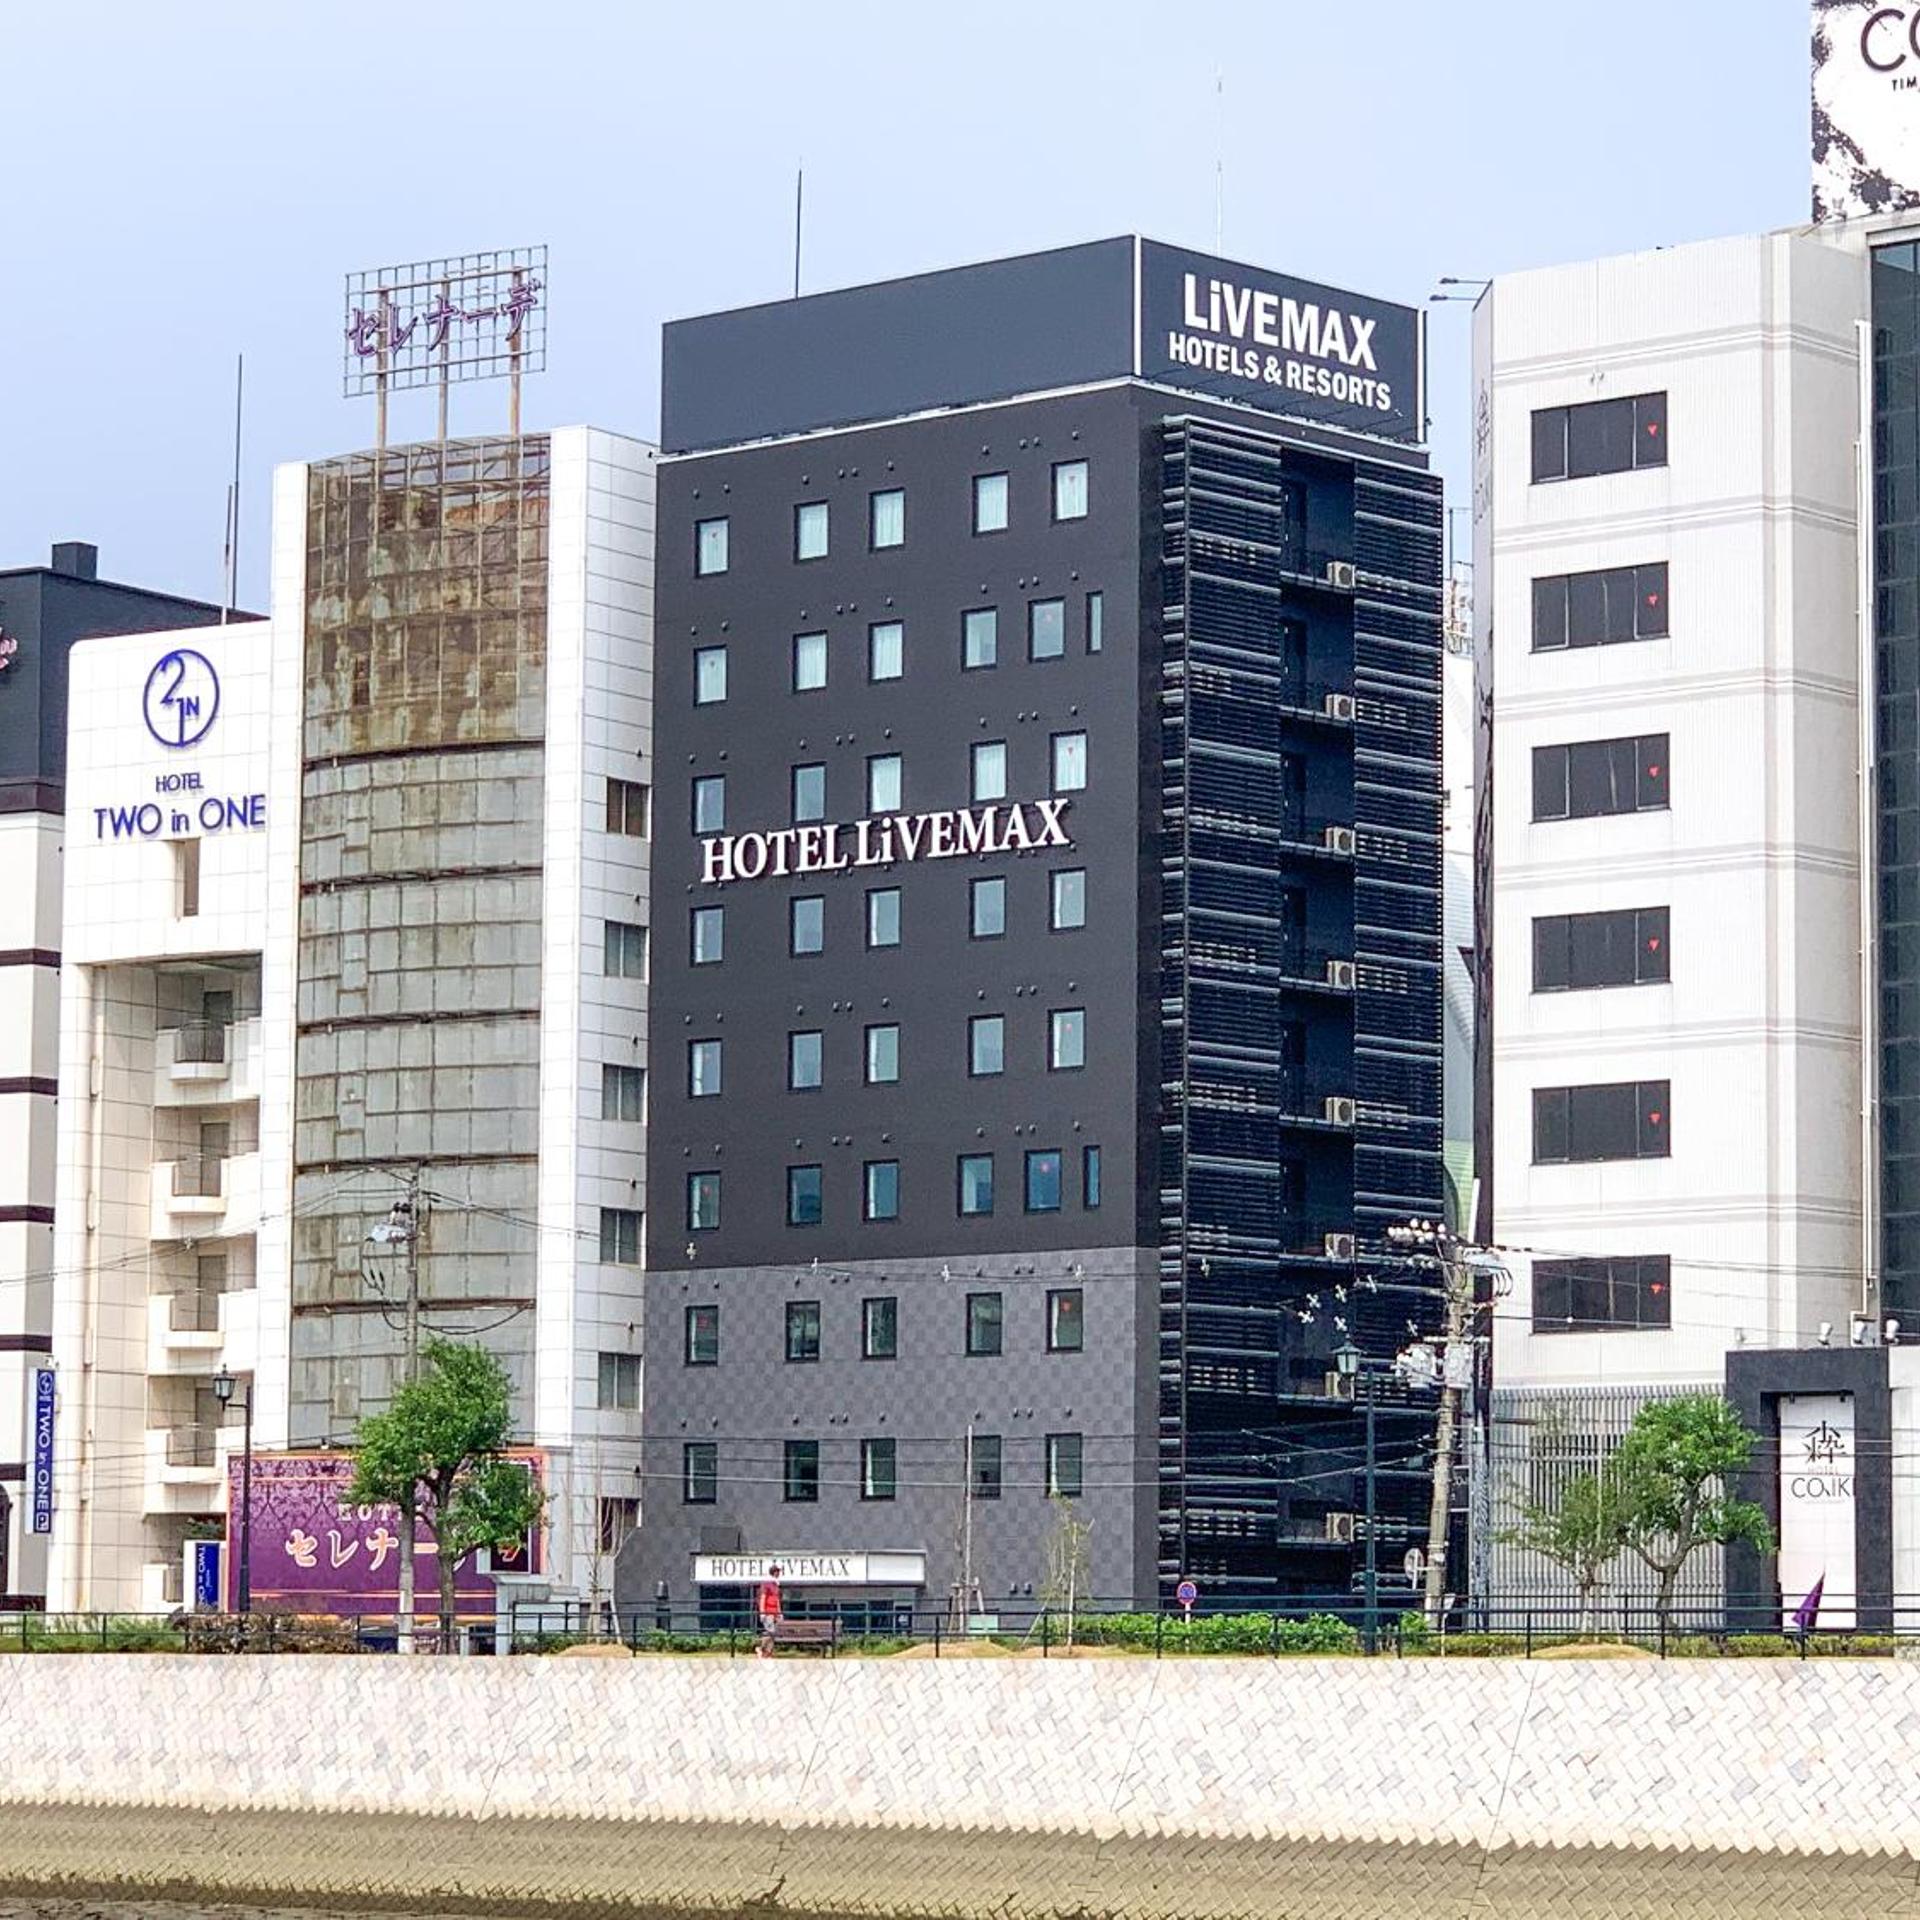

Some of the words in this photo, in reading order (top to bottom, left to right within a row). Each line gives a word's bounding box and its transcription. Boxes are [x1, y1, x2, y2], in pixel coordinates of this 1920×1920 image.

[1861, 8, 1920, 72] C
[348, 277, 544, 358] セレナーデ
[1184, 272, 1378, 372] LiVEMAX
[1168, 331, 1260, 380] HOTELS
[1262, 355, 1283, 386] &
[1286, 359, 1392, 412] RESORTS
[155, 772, 204, 793] HOTEL
[93, 803, 163, 839] TWO
[171, 808, 190, 833] in
[198, 794, 266, 830] ONE
[701, 824, 848, 883] HOTEL
[854, 799, 1070, 867] LiVEMAX
[38, 1405, 51, 1448] TWO
[37, 1469, 50, 1510] ONE
[285, 1528, 466, 1572] セレナー
[711, 1559, 766, 1577] HOTEL
